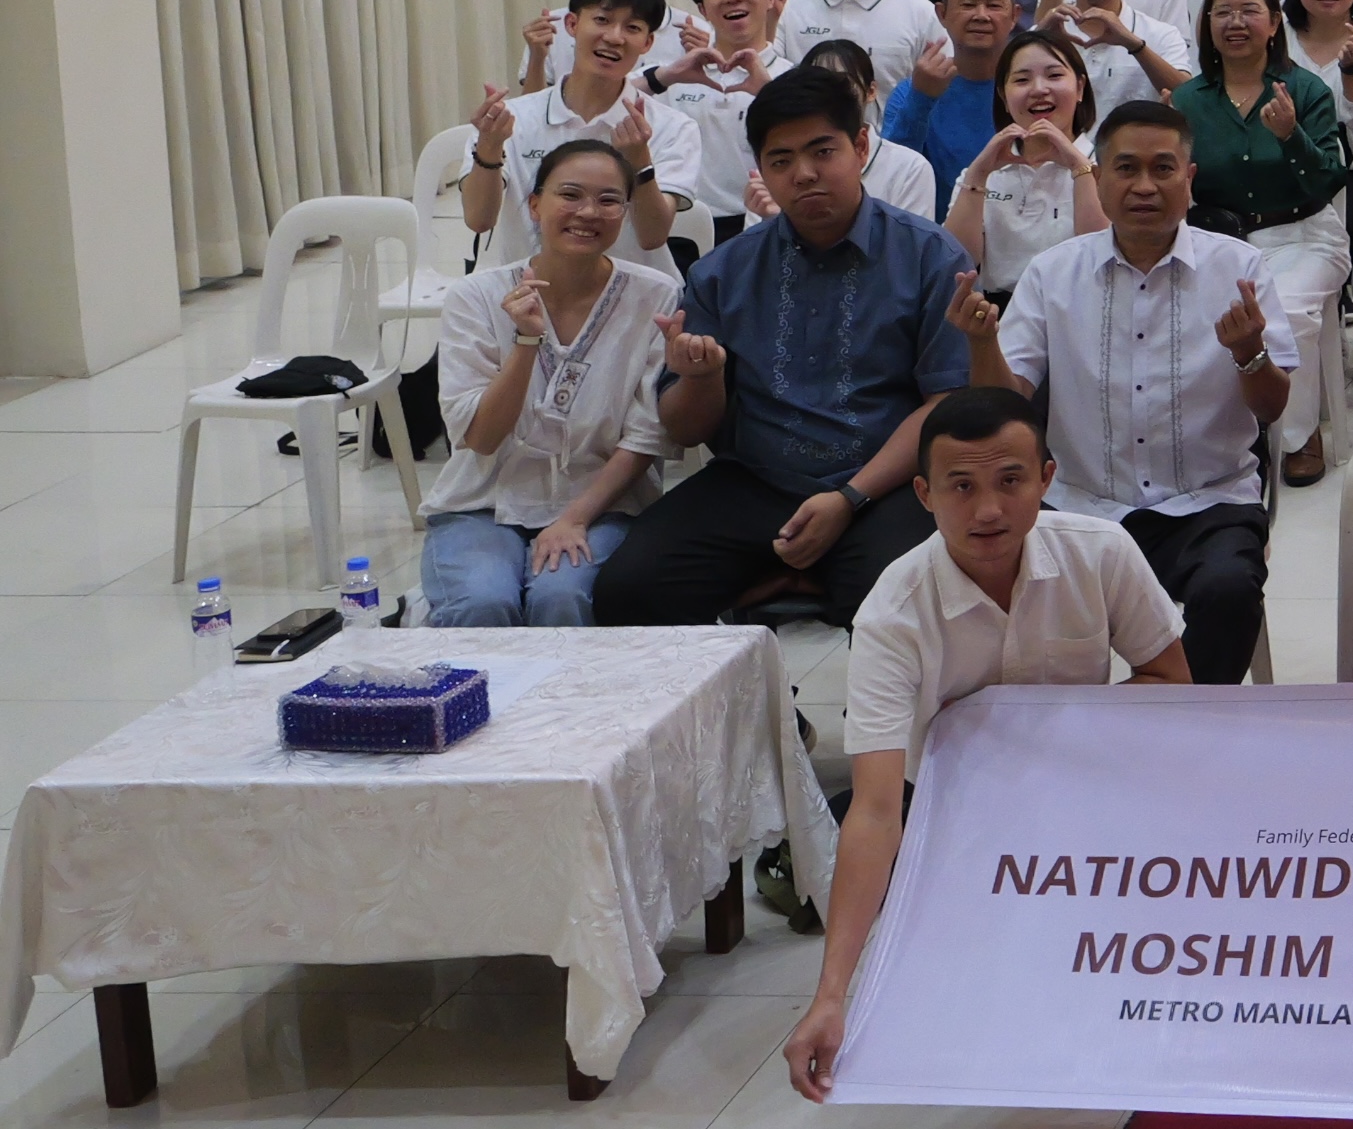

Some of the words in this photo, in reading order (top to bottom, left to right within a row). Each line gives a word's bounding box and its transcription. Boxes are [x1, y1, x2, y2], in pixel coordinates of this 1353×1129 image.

[799, 25, 831, 36] JGLP
[985, 190, 1013, 202] GLP
[1257, 829, 1314, 848] Family
[1072, 931, 1333, 979] MOSHIM
[1119, 999, 1224, 1023] METRO
[1233, 1002, 1352, 1026] MANILA
